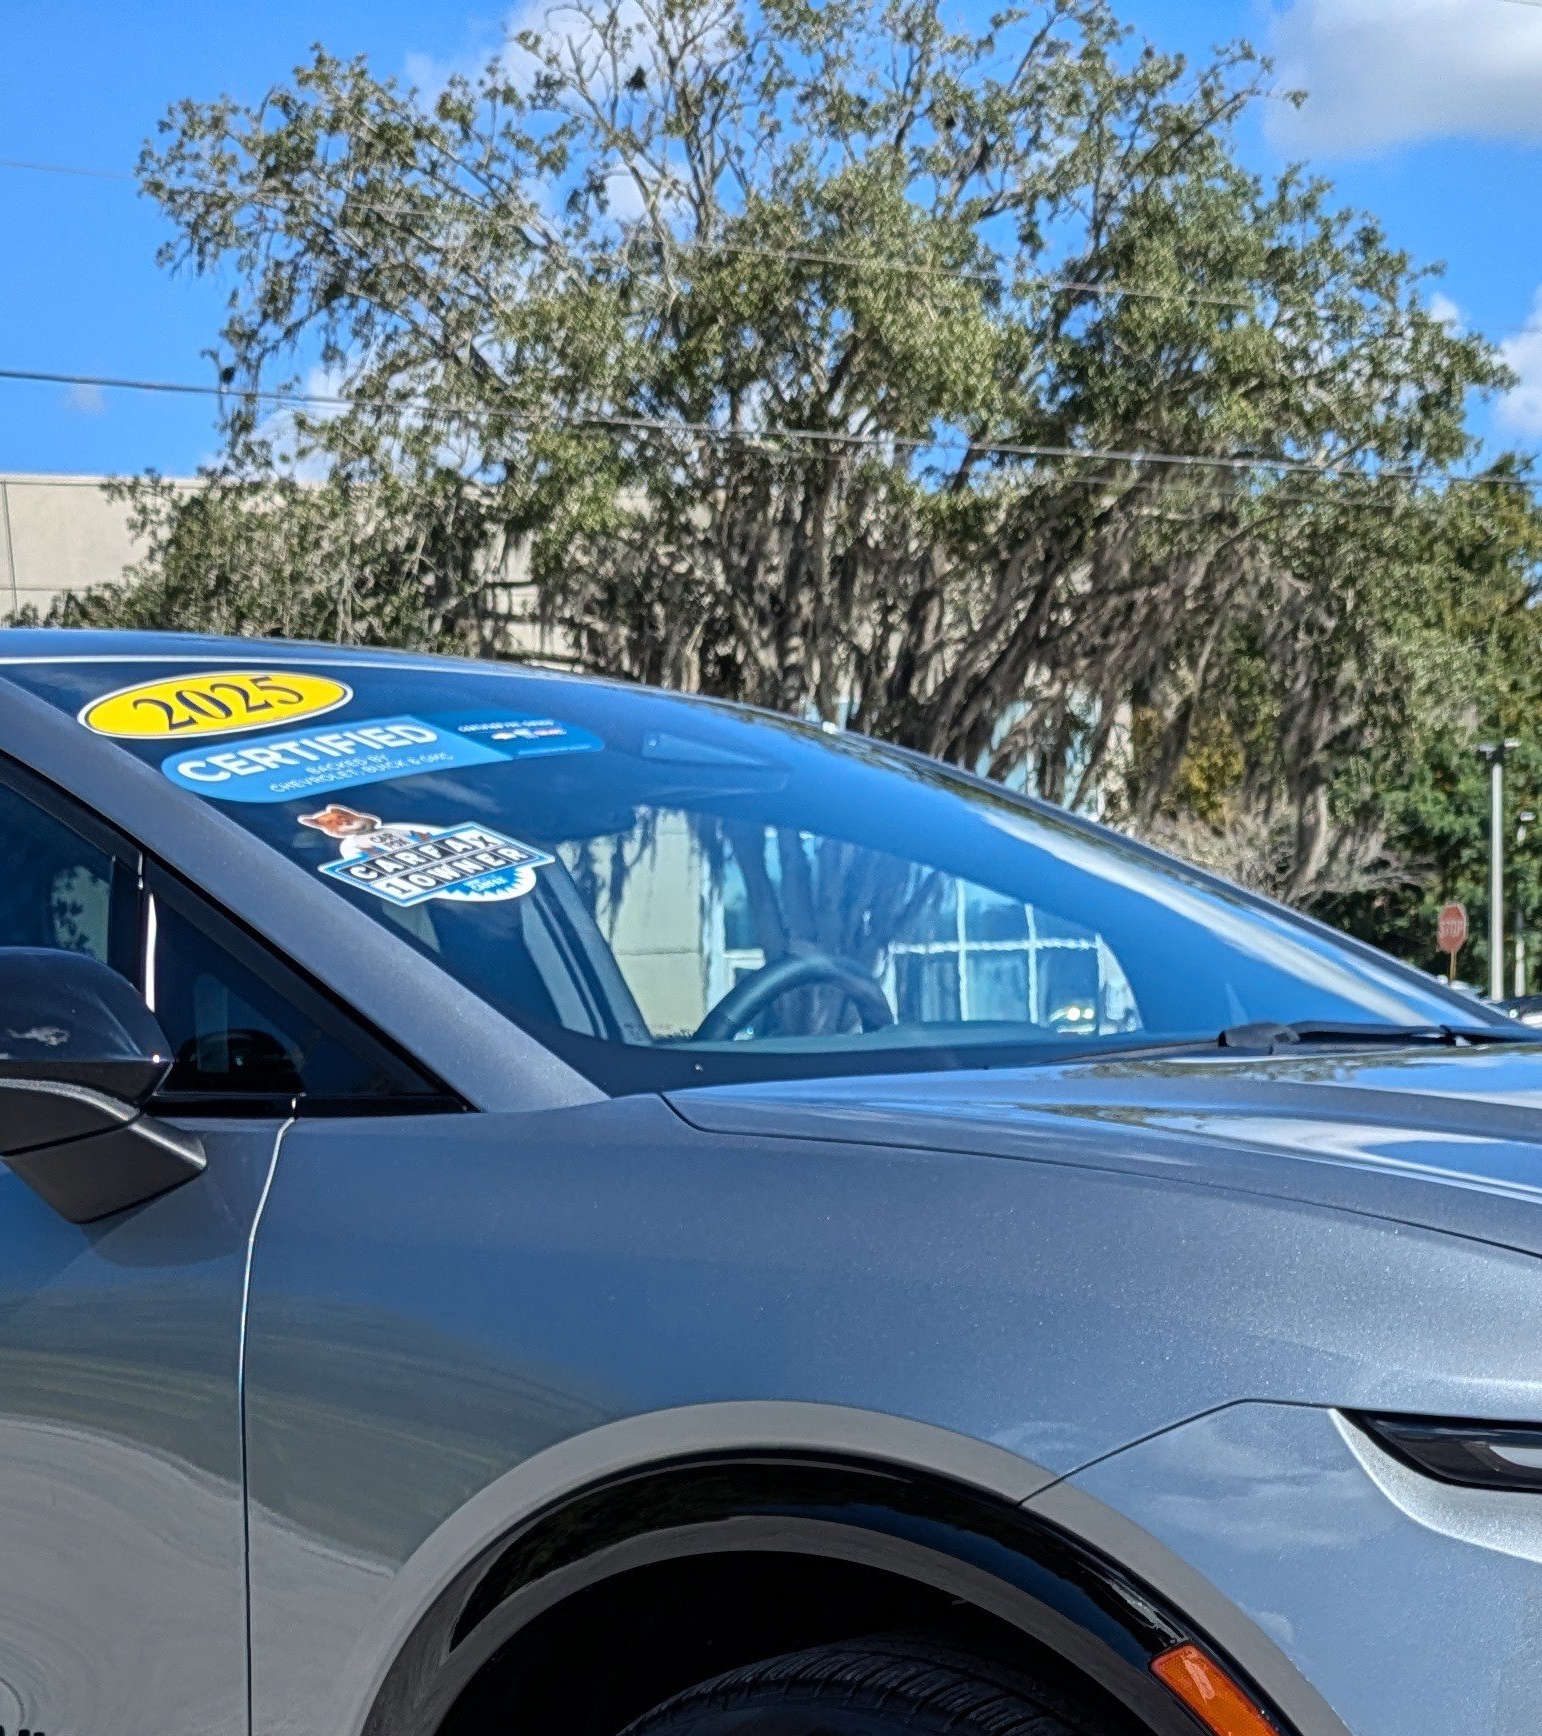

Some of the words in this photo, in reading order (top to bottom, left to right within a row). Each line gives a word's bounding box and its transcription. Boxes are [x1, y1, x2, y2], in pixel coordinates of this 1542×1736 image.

[132, 676, 304, 731] 2025
[177, 724, 439, 782] CERTIFIED
[349, 833, 501, 880] CARFAX
[408, 847, 529, 888] OWNER
